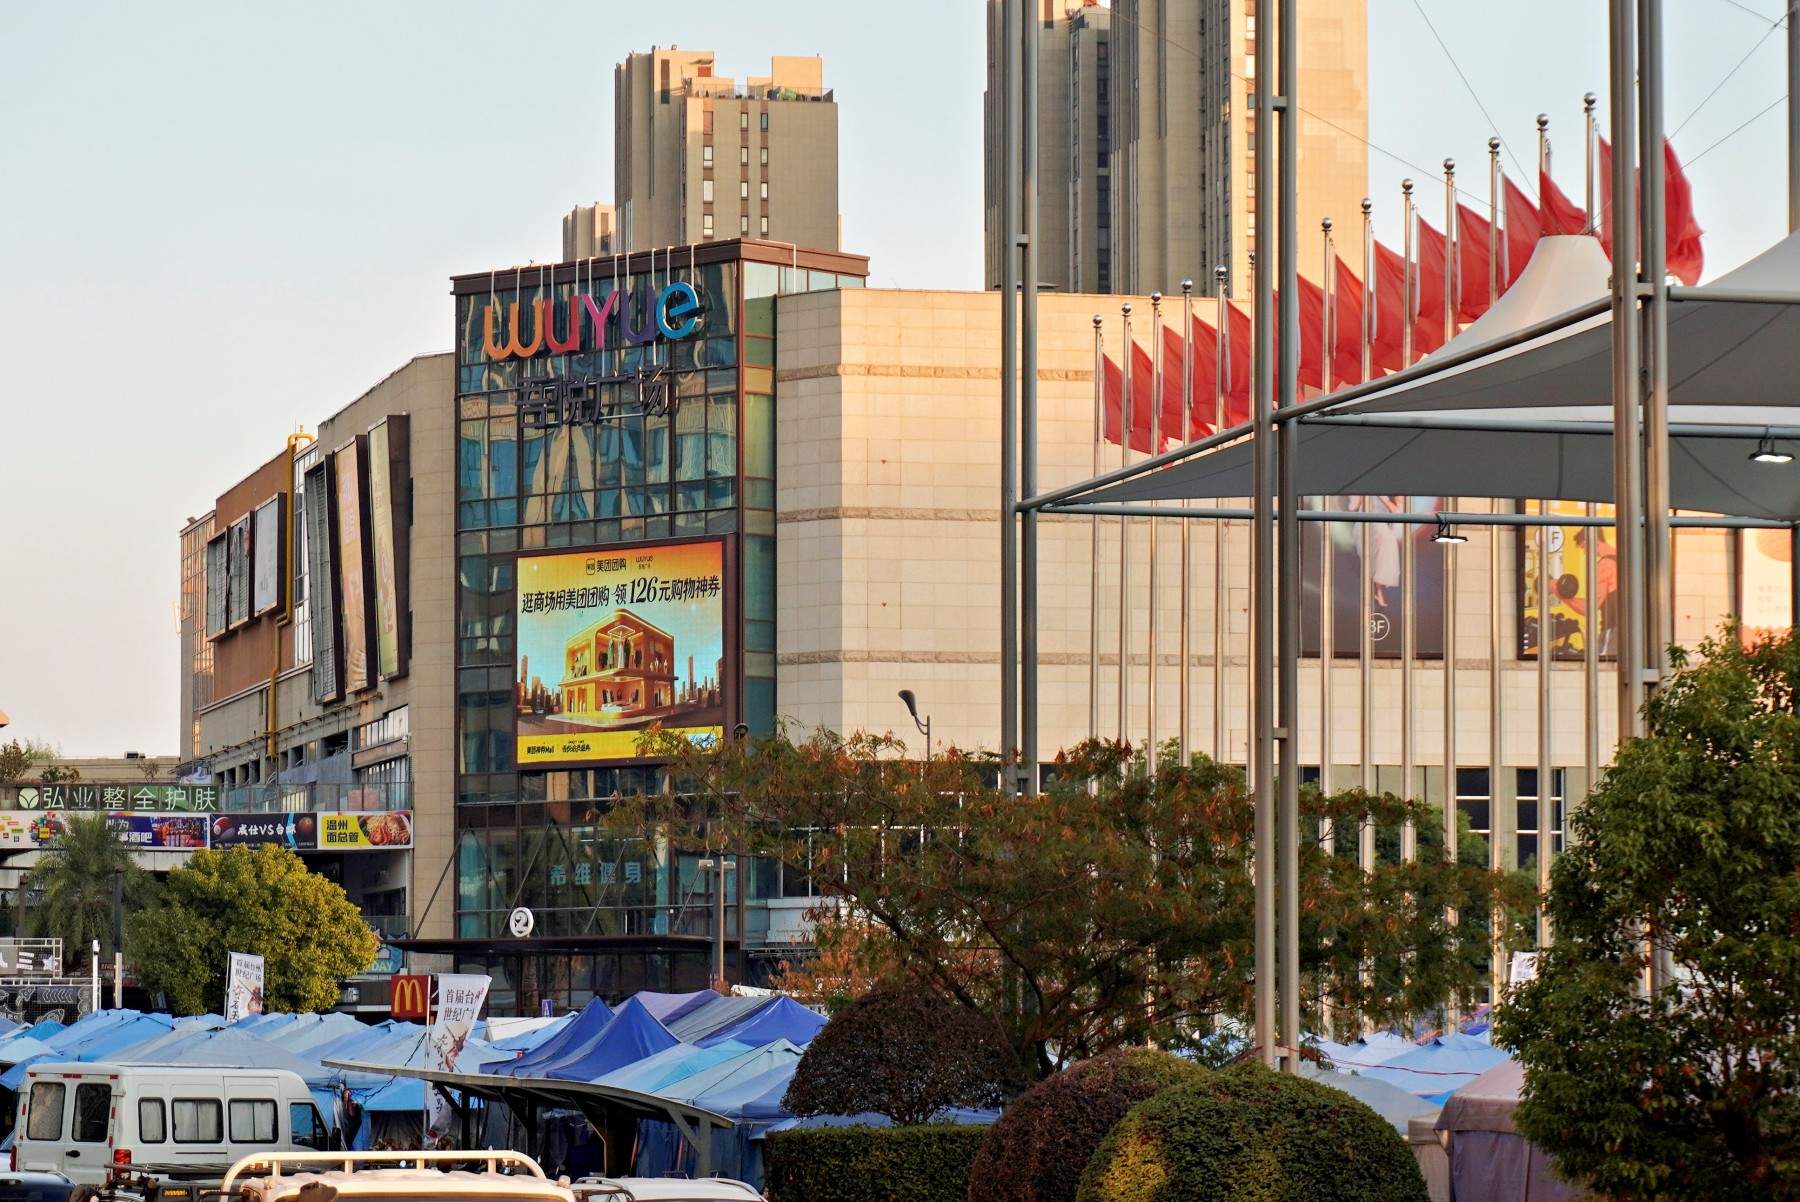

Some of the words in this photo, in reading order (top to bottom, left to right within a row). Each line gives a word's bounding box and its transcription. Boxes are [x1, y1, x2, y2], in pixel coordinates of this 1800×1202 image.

[518, 366, 671, 429] 吾悦广场
[43, 786, 216, 811] 弘业整全护肤
[326, 819, 348, 831] 温州
[326, 832, 359, 843] 面总管
[443, 1007, 475, 1022] 世纪广
